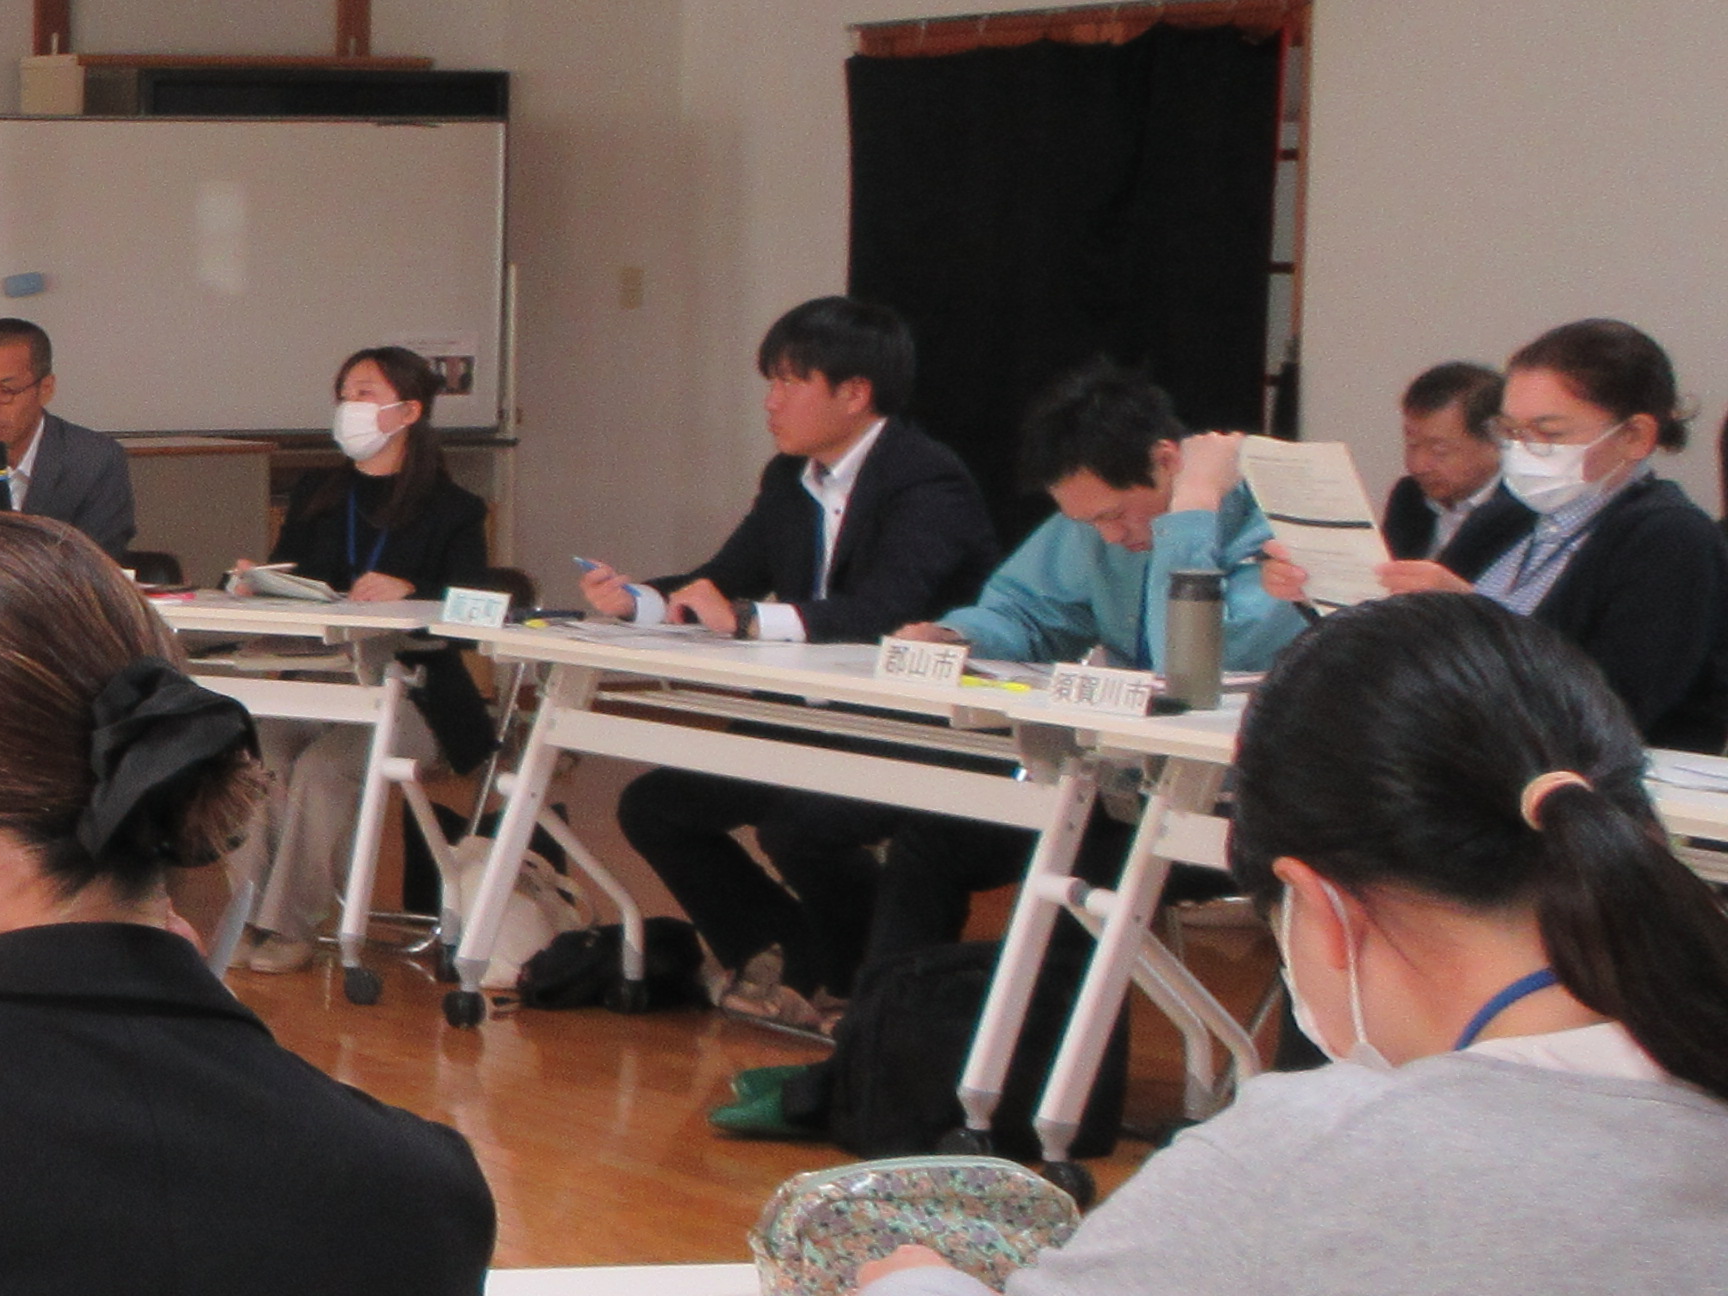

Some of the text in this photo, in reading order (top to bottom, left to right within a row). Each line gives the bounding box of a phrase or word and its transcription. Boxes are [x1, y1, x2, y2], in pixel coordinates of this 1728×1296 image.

[885, 645, 956, 681] 郡山市
[1053, 671, 1148, 710] 須賀川市
